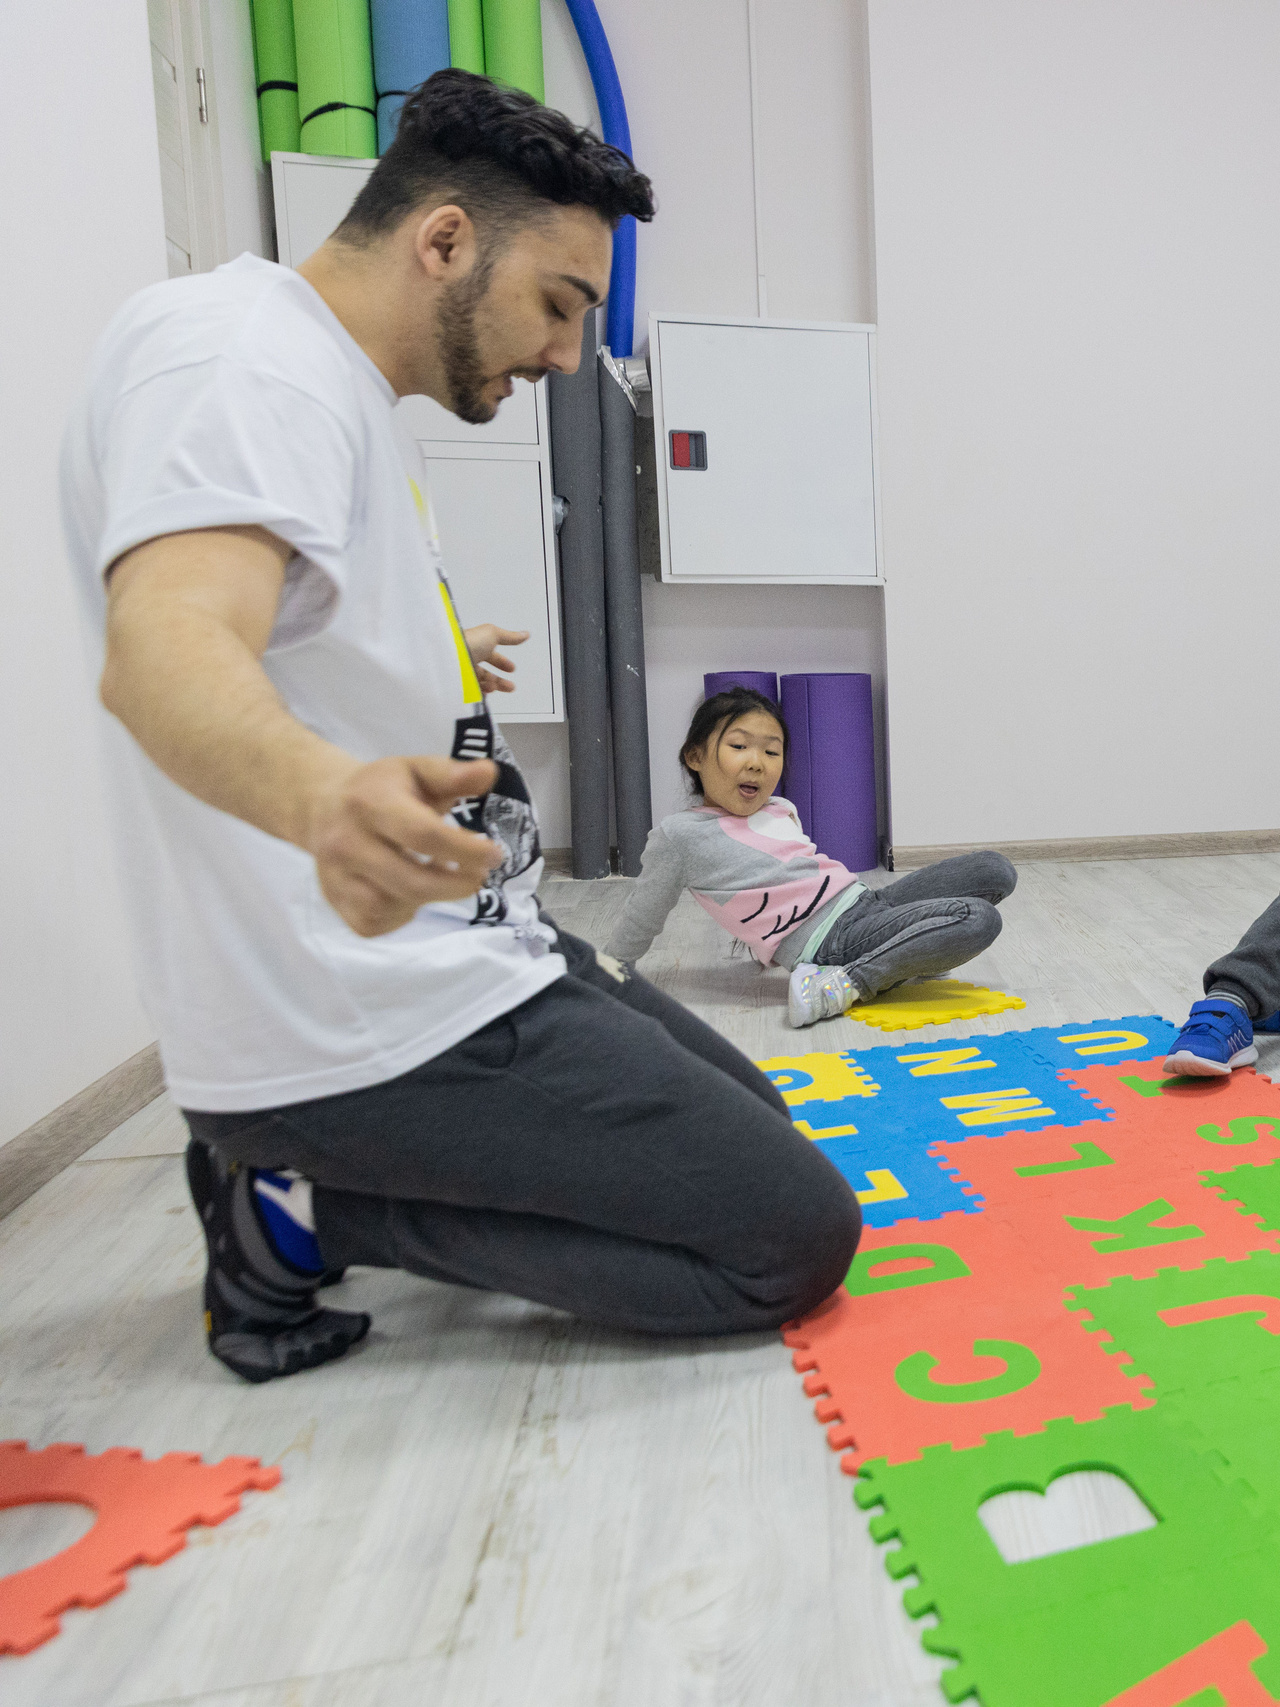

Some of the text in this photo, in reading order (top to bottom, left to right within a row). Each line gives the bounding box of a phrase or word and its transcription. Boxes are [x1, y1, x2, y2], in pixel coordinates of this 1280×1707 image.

[896, 1047, 997, 1077] N
[1057, 1030, 1149, 1056] U
[939, 1087, 1057, 1127] M
[1012, 1141, 1117, 1178] L
[1062, 1197, 1207, 1255] K
[842, 1242, 973, 1298] D
[893, 1338, 1043, 1405] C
